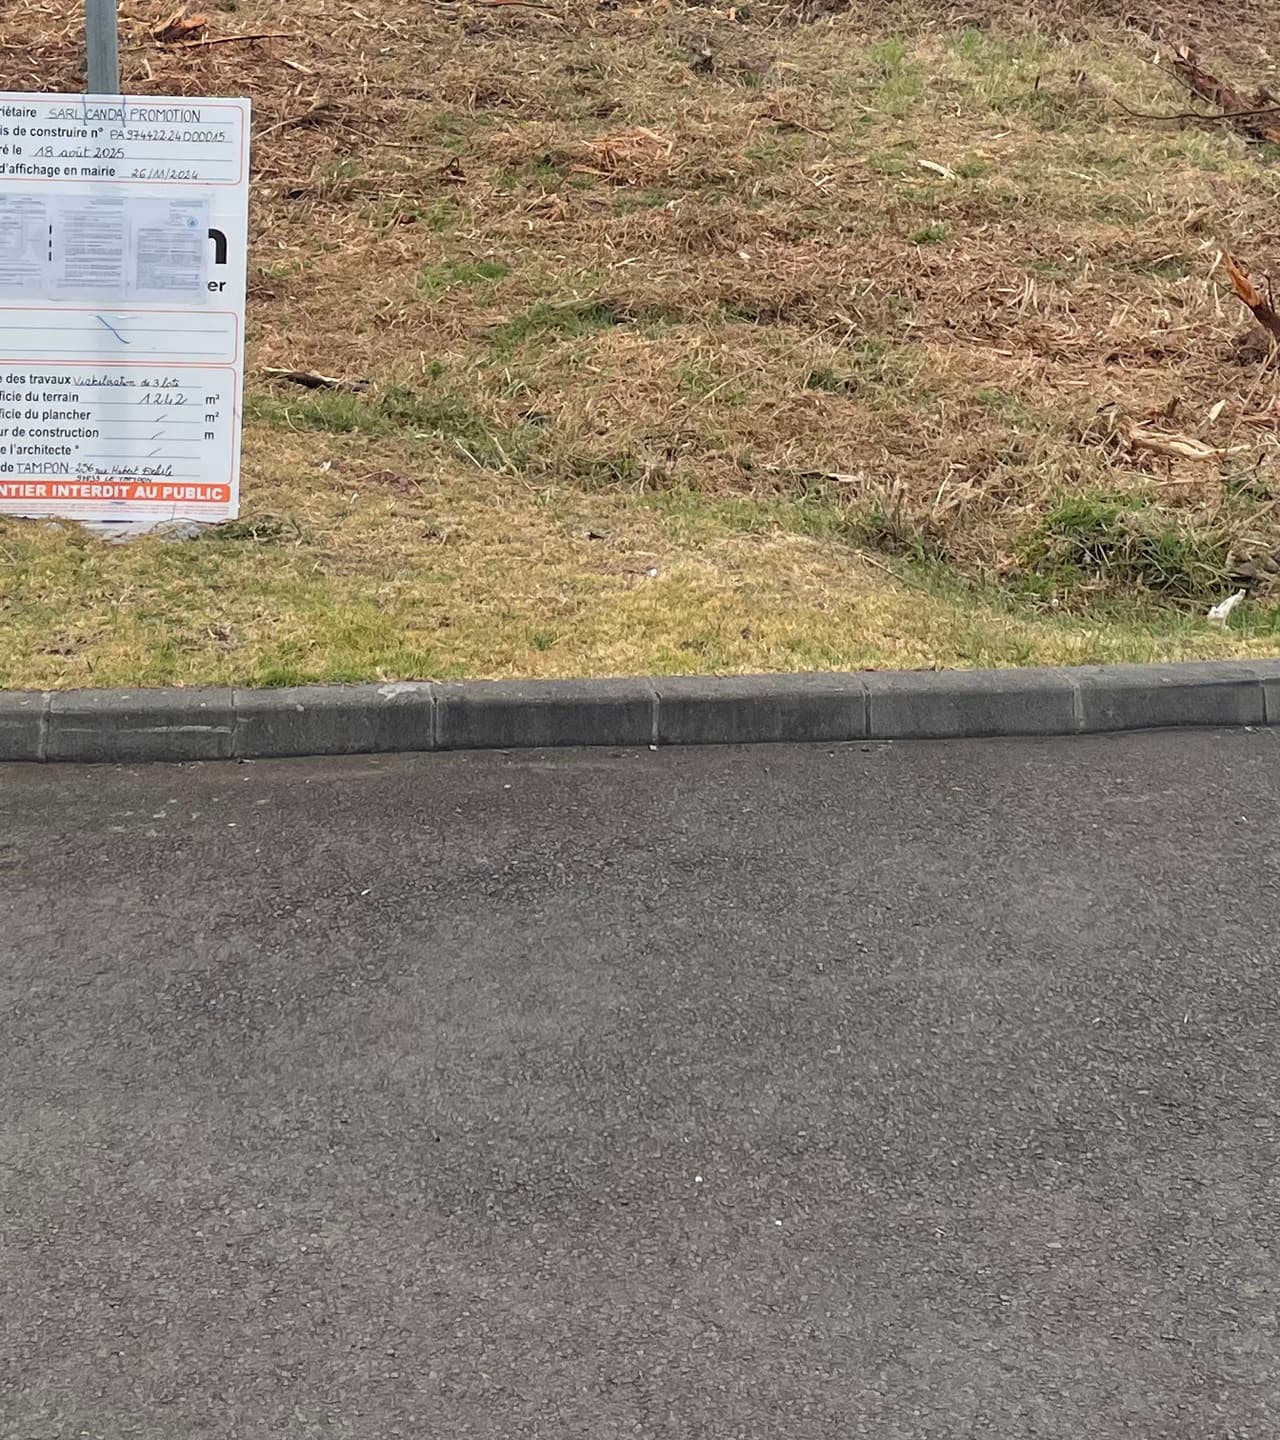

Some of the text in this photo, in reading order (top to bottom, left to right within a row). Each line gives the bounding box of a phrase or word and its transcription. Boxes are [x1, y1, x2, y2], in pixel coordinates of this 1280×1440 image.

[48, 108, 83, 120] SARL
[130, 109, 200, 122] PROMOTION
[13, 125, 27, 137] de
[30, 126, 87, 138] construire
[91, 127, 104, 138] n°
[12, 144, 22, 155] le
[34, 146, 54, 158] 18
[63, 167, 78, 176] en
[81, 166, 116, 177] mairie
[6, 373, 26, 384] des
[30, 374, 71, 385] travaux
[25, 391, 40, 402] du
[42, 392, 80, 403] terrain
[24, 408, 39, 420] du
[42, 409, 91, 422] plancher
[12, 426, 26, 438] de
[28, 427, 99, 439] construction
[204, 431, 215, 440] m
[9, 444, 72, 456] l'architecte
[0, 462, 15, 473] de
[16, 462, 69, 474] TAMPON
[52, 485, 130, 498] INTERDIT
[134, 486, 158, 498] AU
[163, 486, 224, 500] PUBLIC
